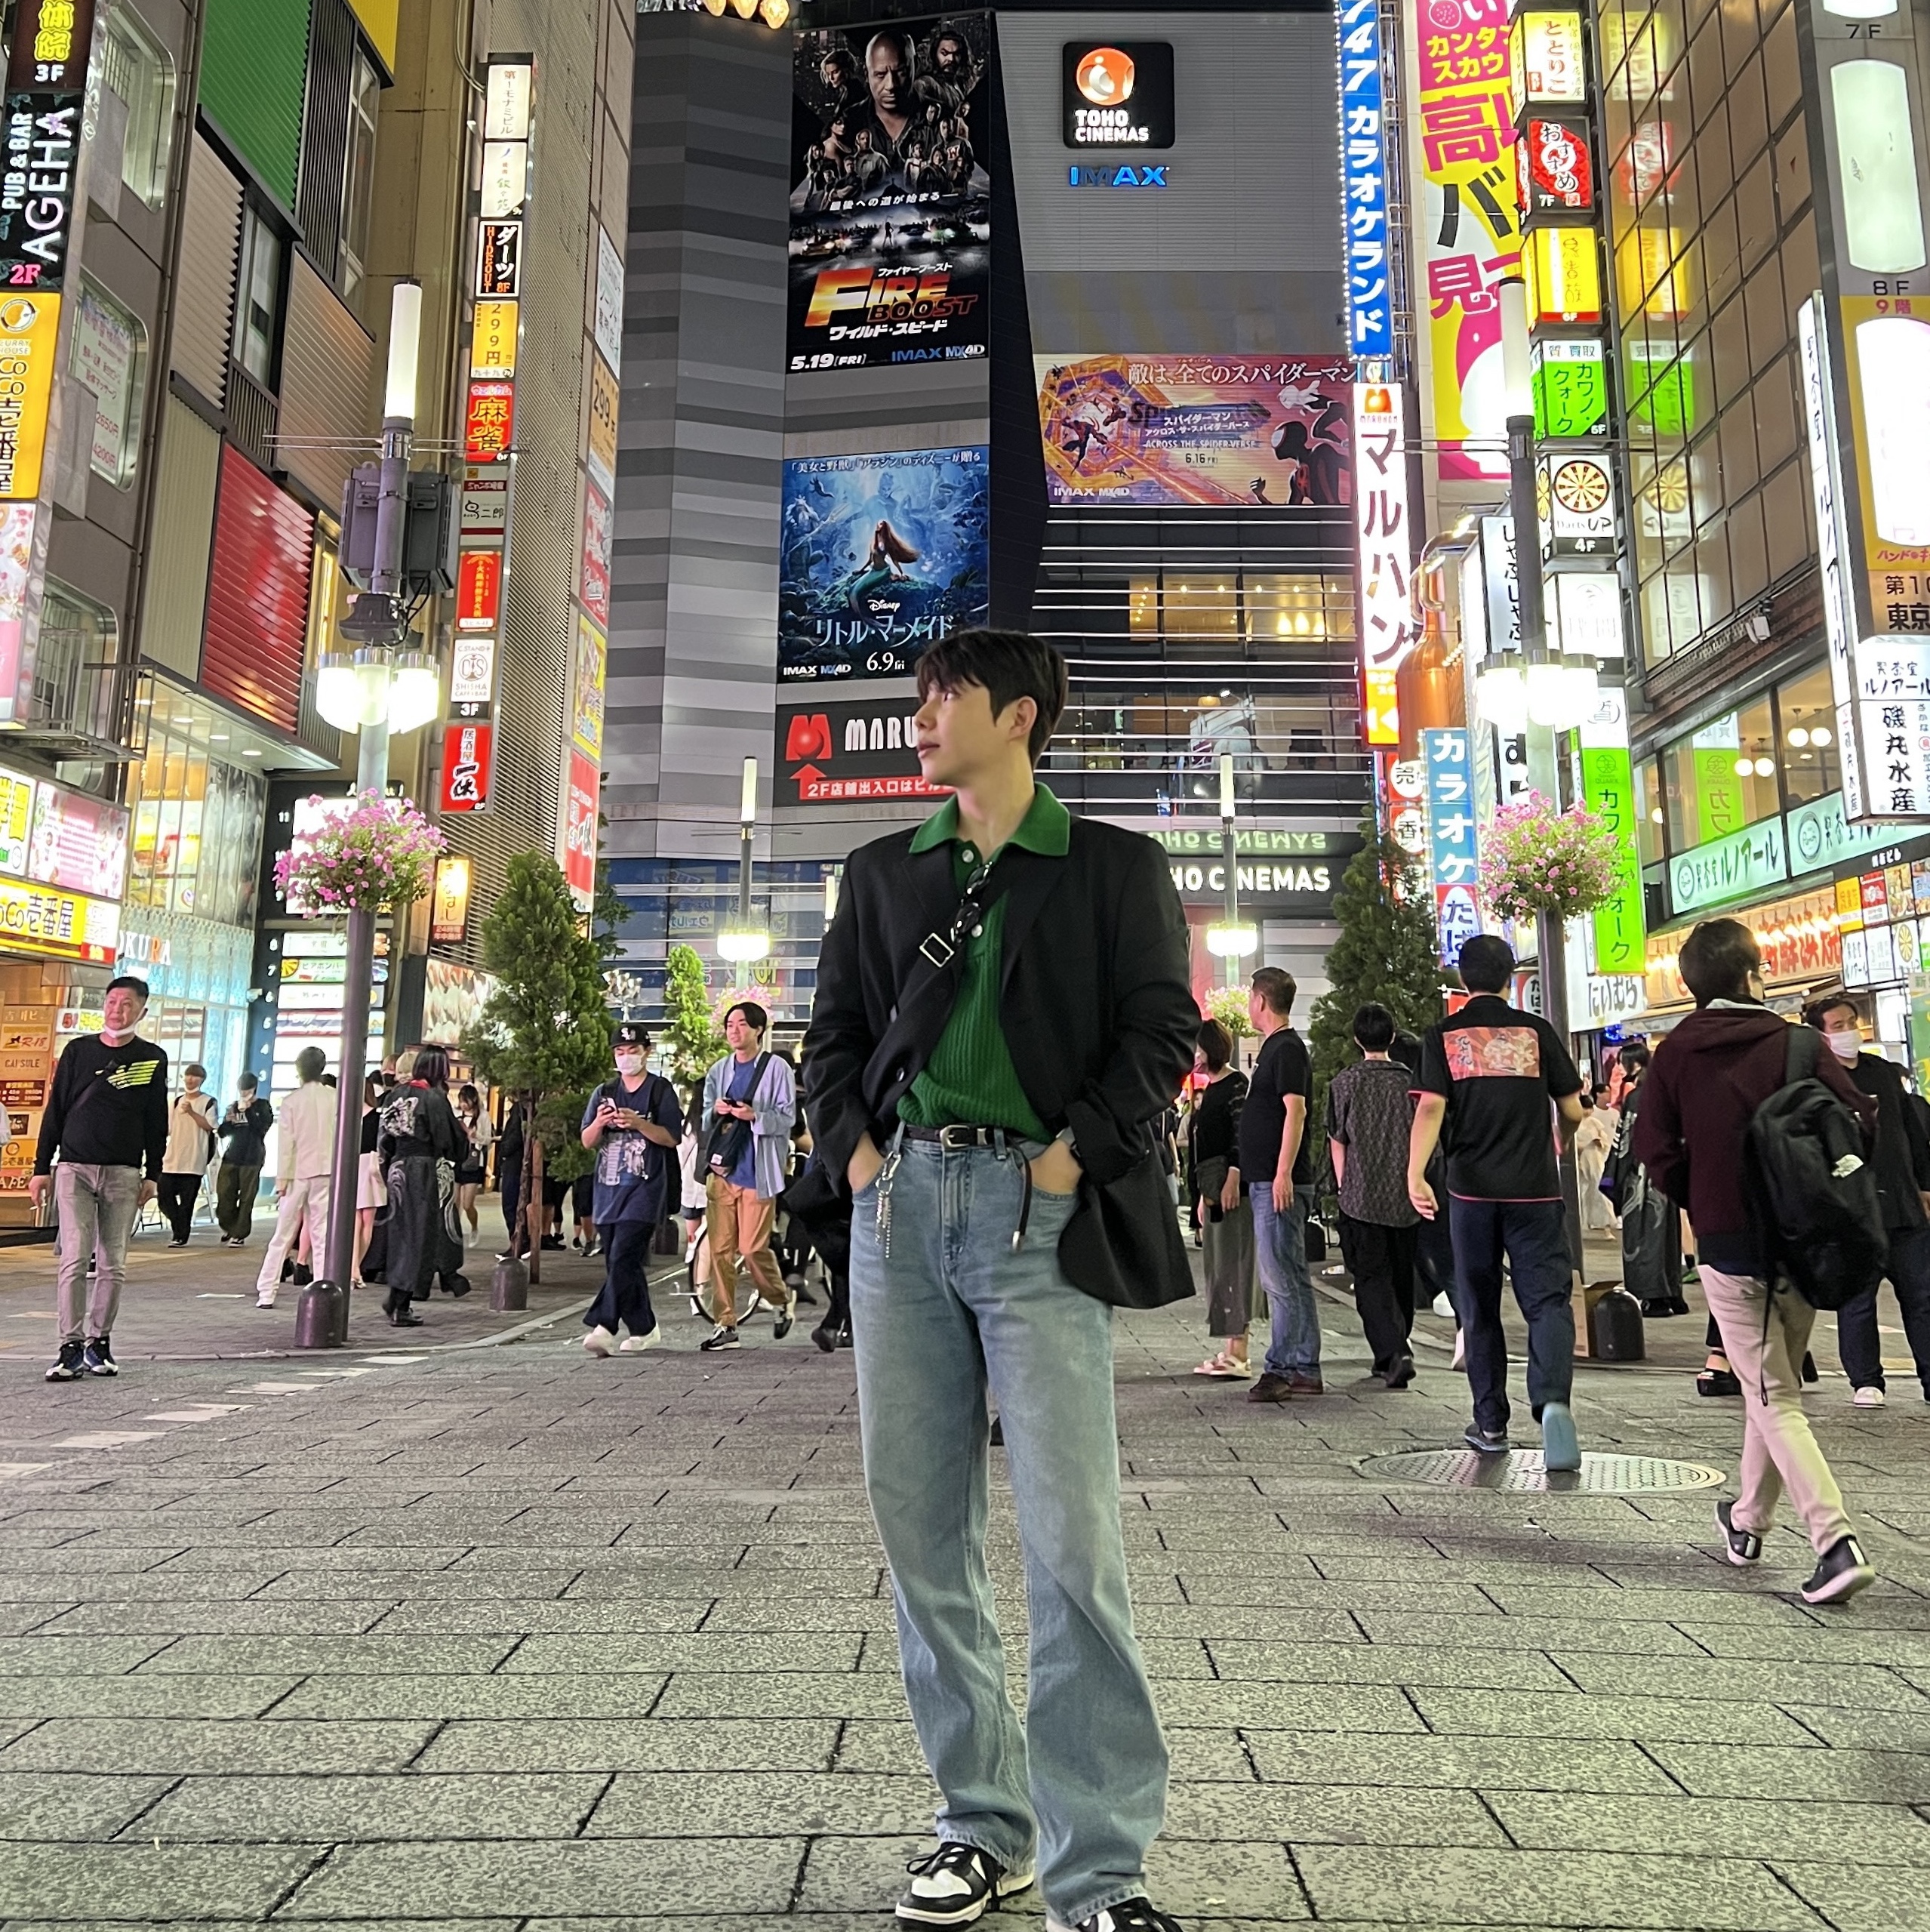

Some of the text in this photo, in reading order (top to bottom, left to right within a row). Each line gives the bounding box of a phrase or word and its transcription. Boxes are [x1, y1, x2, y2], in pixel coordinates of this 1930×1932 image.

[1544, 20, 1568, 95] ととりこ
[34, 64, 65, 82] 3F
[1074, 109, 1129, 128] TOHO
[1074, 126, 1150, 143] CINEMAS
[2, 112, 33, 211] PUB & BAR
[1542, 123, 1577, 191] おすすめ
[21, 107, 75, 262] AGEHA
[1069, 165, 1167, 186] IMAX
[1538, 194, 1556, 207] 7F
[483, 226, 495, 293] HIDEOUT
[495, 226, 518, 280] ダーツ
[9, 263, 42, 285] 2F
[496, 282, 511, 293] 8F
[805, 267, 951, 328] FIRE
[866, 294, 979, 323] BOOST
[485, 304, 501, 365] 299円
[830, 319, 948, 341] ワイルド・スピード
[891, 344, 986, 363] IMAX MX4D
[468, 397, 511, 451] 麻雀
[1163, 412, 1231, 427] スパイダーマン
[1144, 439, 1177, 448] ACROSS
[1185, 453, 1205, 464] 6.16
[1054, 487, 1095, 496] IMAX
[1588, 517, 1612, 532] UP
[1361, 429, 1407, 665] マルハン
[1574, 538, 1596, 553] 4F
[816, 614, 954, 648] リトル・マーメイド
[783, 664, 818, 676] IMAX
[866, 652, 894, 672] 6.9
[460, 703, 480, 716] 3F
[1882, 704, 1917, 812] 磯丸水産
[1432, 732, 1475, 884] カラオケ
[1208, 867, 1331, 892] CNEMAS
